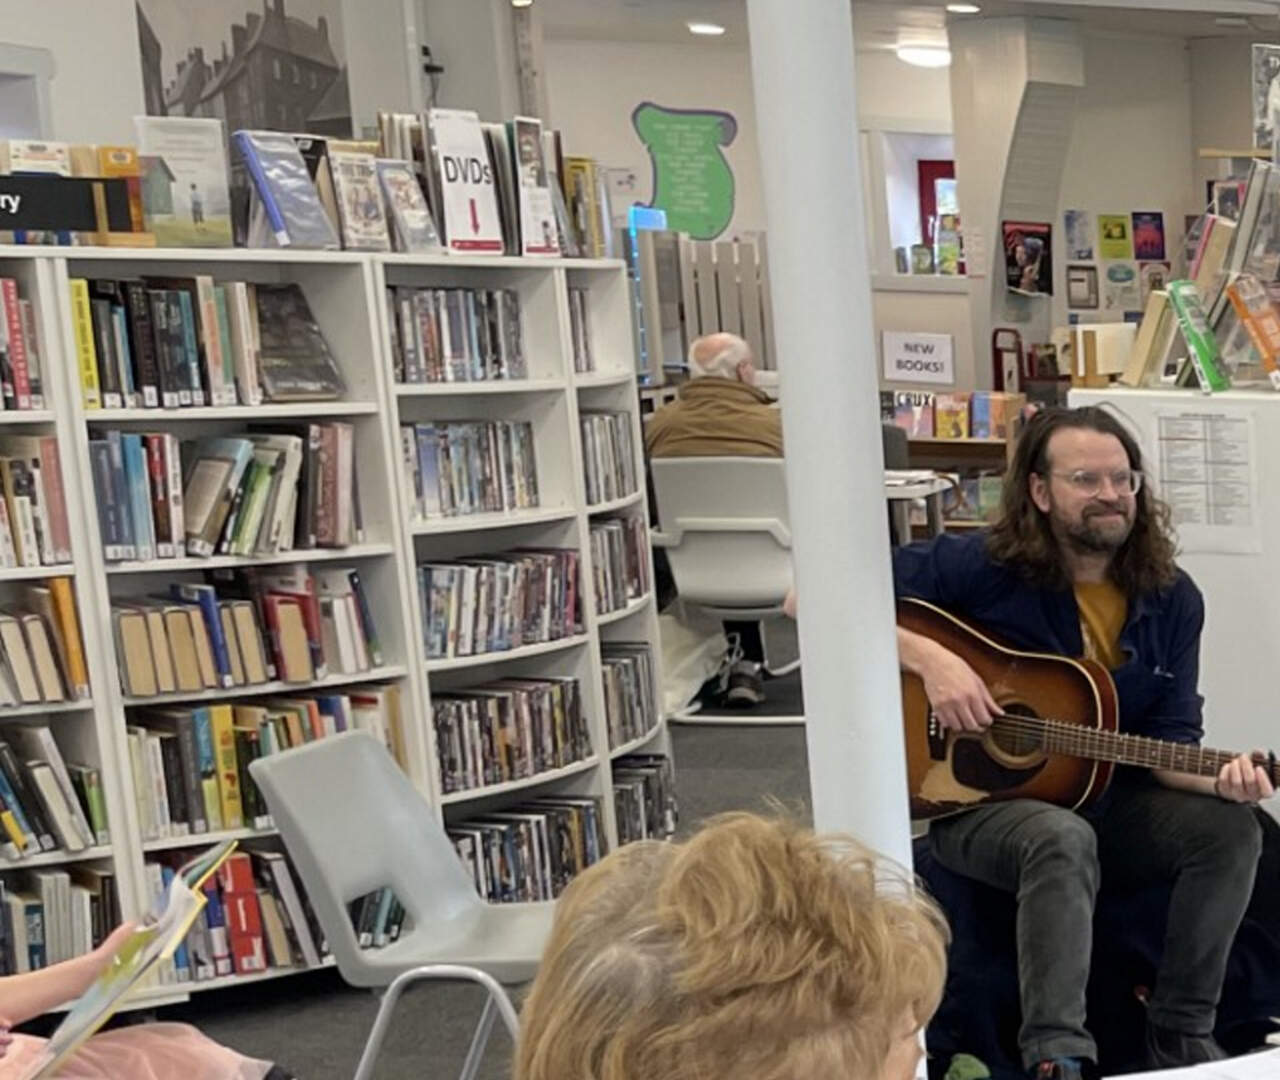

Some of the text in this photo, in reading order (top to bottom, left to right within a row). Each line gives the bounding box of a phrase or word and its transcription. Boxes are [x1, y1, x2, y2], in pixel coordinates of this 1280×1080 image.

[443, 156, 492, 185] DVDs
[904, 343, 935, 354] NEW
[896, 359, 944, 373] BOOKS!
